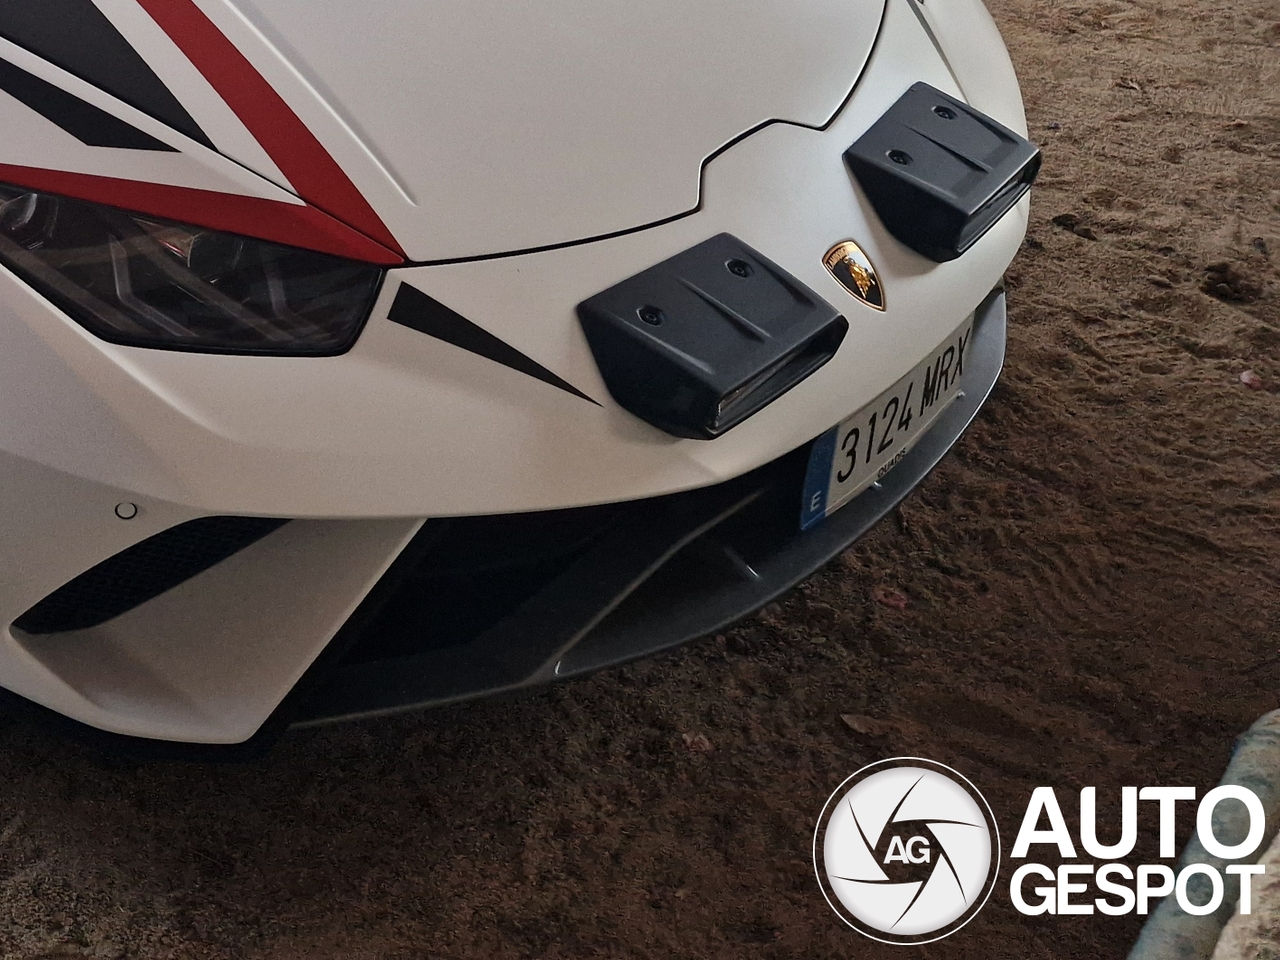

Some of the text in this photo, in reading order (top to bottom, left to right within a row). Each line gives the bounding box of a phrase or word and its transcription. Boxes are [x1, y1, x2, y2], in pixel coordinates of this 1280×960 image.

[837, 327, 971, 483] 3124 MRX
[810, 491, 821, 512] E
